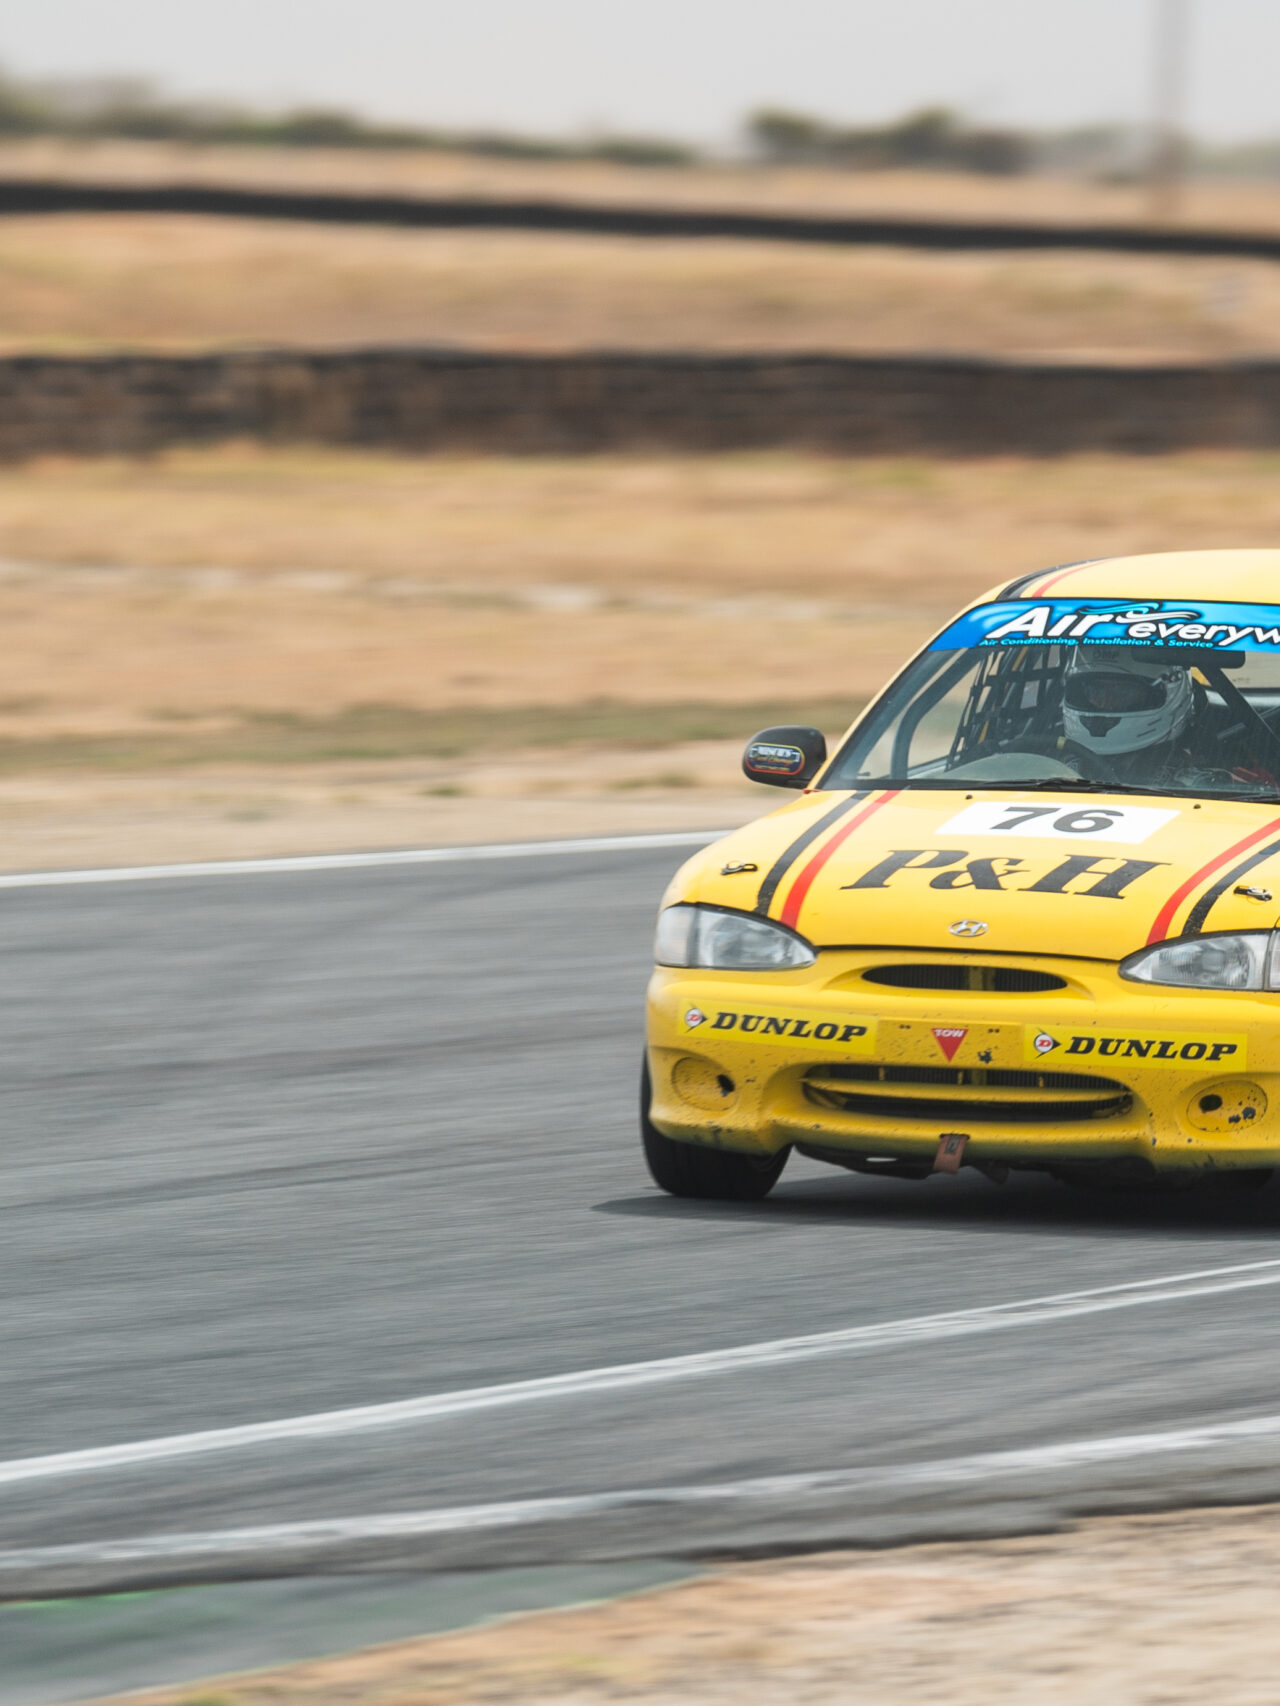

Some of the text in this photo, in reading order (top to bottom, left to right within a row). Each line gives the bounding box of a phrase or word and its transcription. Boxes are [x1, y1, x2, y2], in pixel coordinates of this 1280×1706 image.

[985, 606, 1113, 638] Air
[1083, 638, 1151, 646] Installation
[1168, 640, 1214, 648] Service
[990, 807, 1124, 833] 76
[839, 850, 1172, 899] P&H
[711, 1011, 868, 1042] DUNLOP
[934, 1029, 966, 1038] TOW
[1064, 1036, 1238, 1061] DUNLOP
